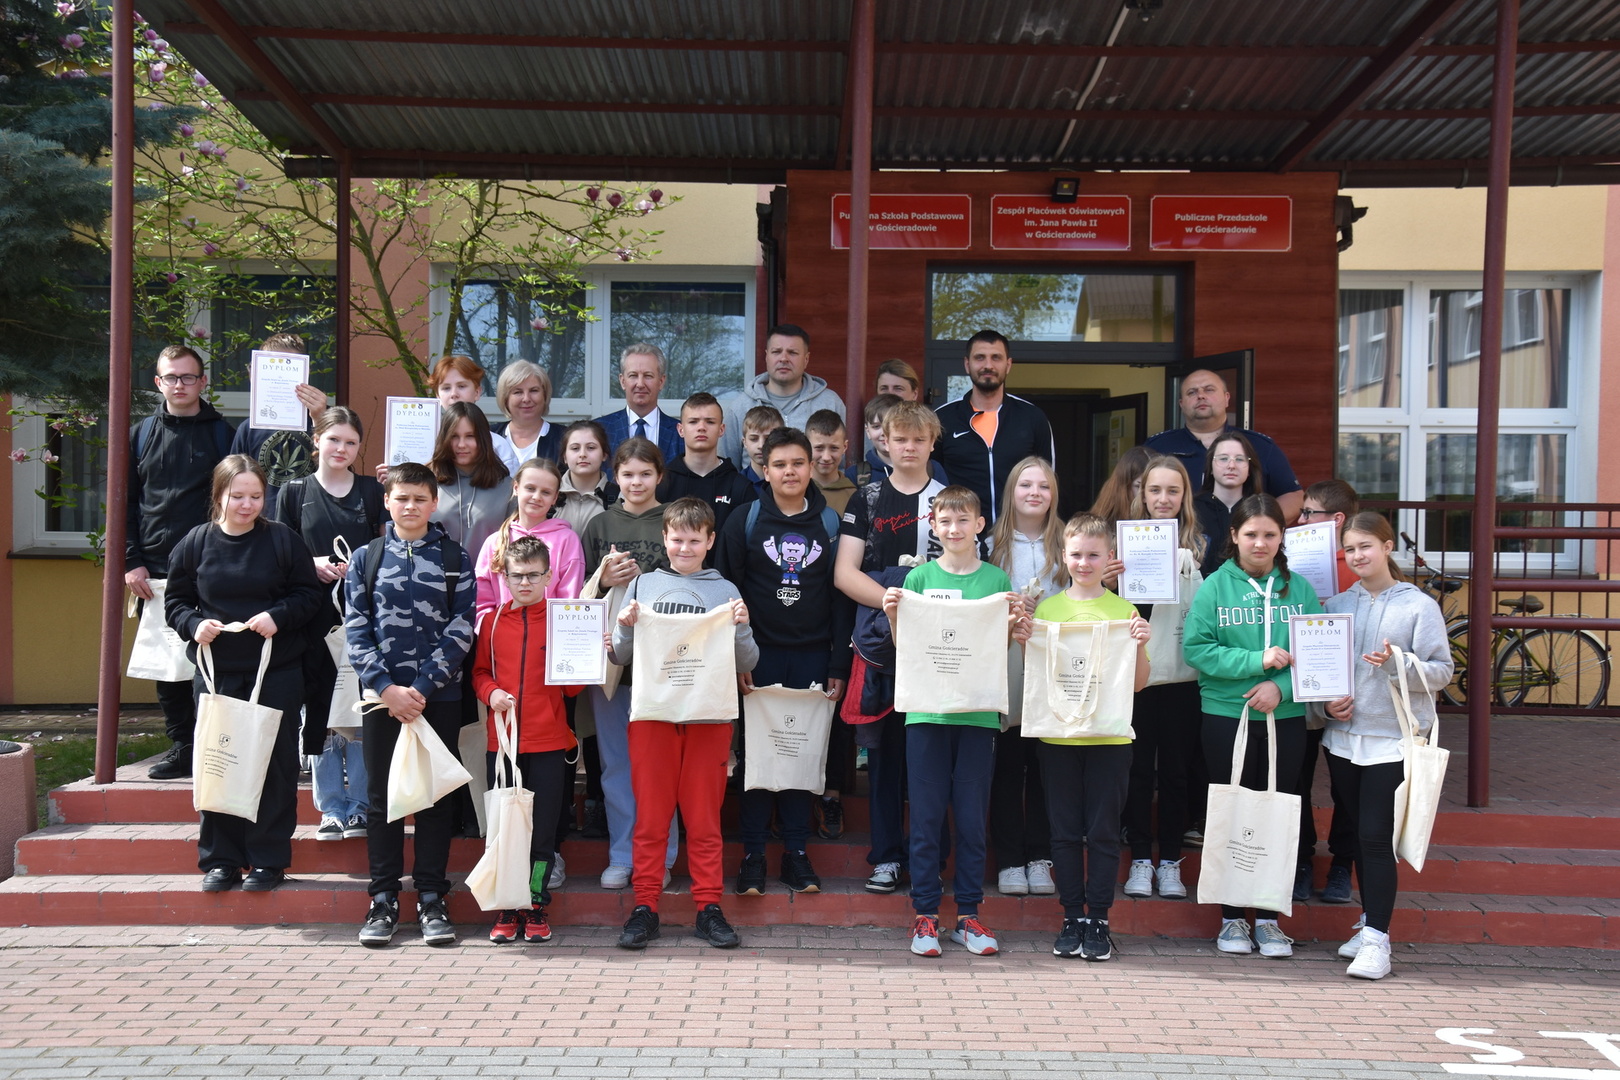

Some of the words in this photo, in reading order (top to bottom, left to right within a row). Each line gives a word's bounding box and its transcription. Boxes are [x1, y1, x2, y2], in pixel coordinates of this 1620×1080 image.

[998, 207, 1025, 216] Zespół
[1069, 207, 1125, 216] Oświatowych
[876, 223, 937, 231] Gościeradowie
[1195, 225, 1257, 233] Gościeradowie
[1035, 230, 1096, 238] Gościeradowie
[1290, 536, 1324, 545] DYPLOM
